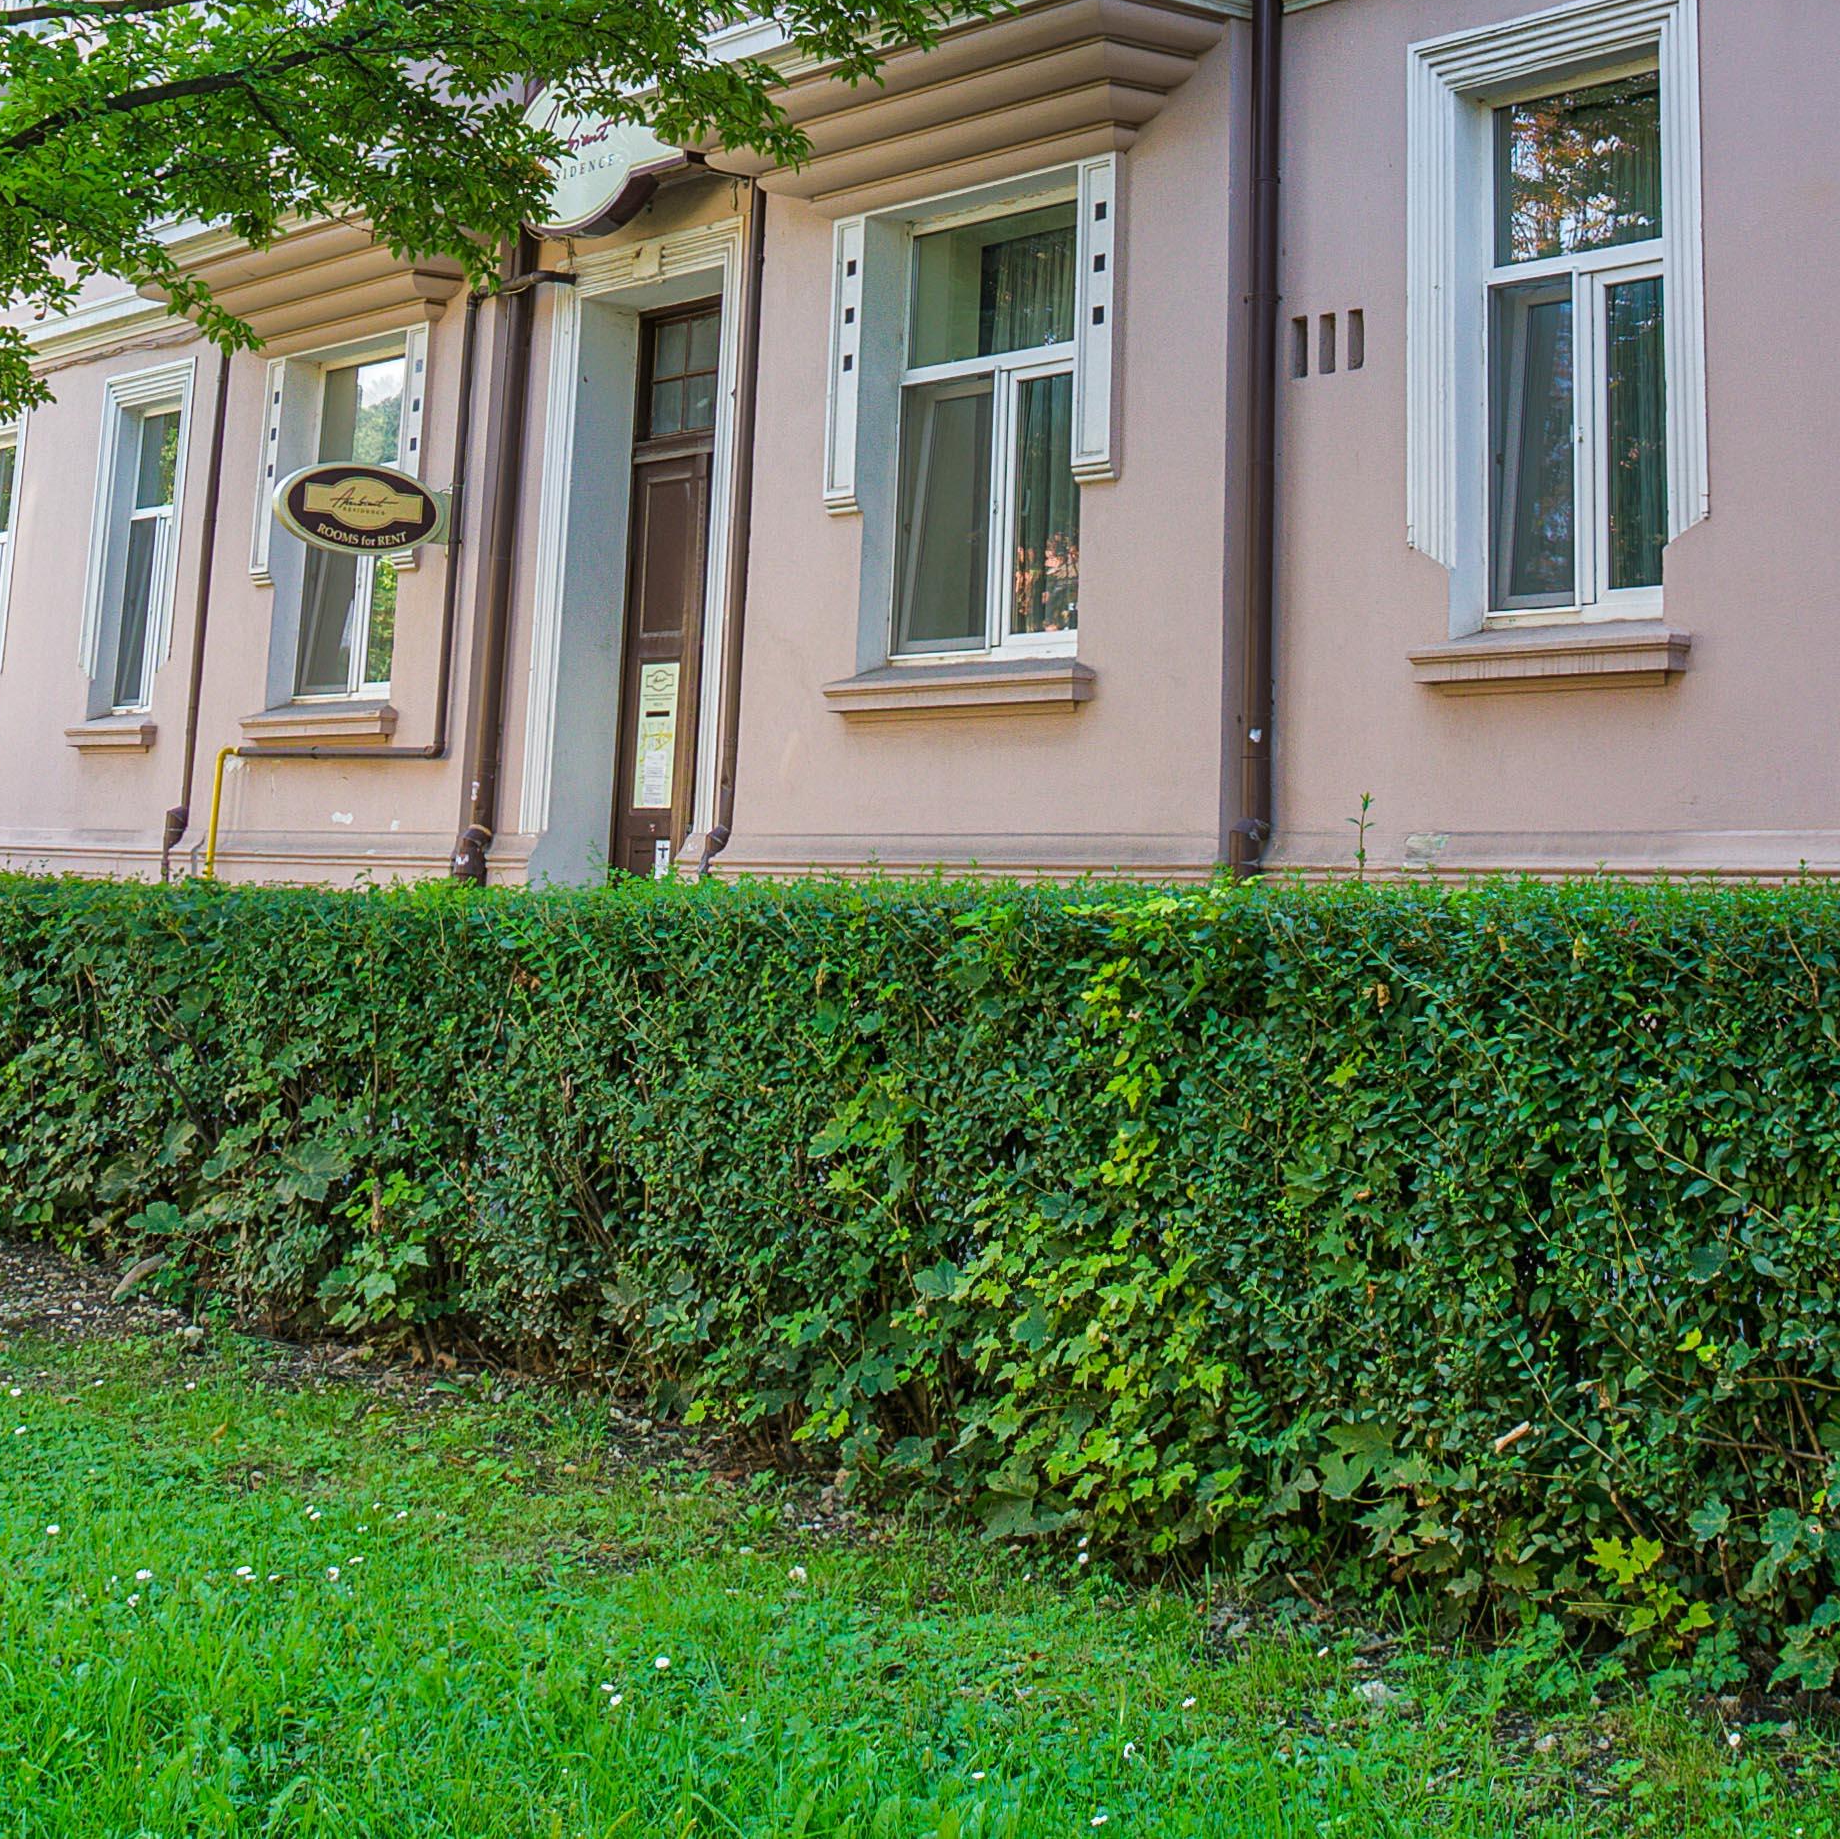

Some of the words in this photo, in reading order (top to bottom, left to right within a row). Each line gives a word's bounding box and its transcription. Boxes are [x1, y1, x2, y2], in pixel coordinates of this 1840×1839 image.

[556, 153, 615, 179] SIDENCE
[317, 523, 359, 544] ROOMS
[361, 535, 376, 546] for
[377, 531, 407, 546] RENT
